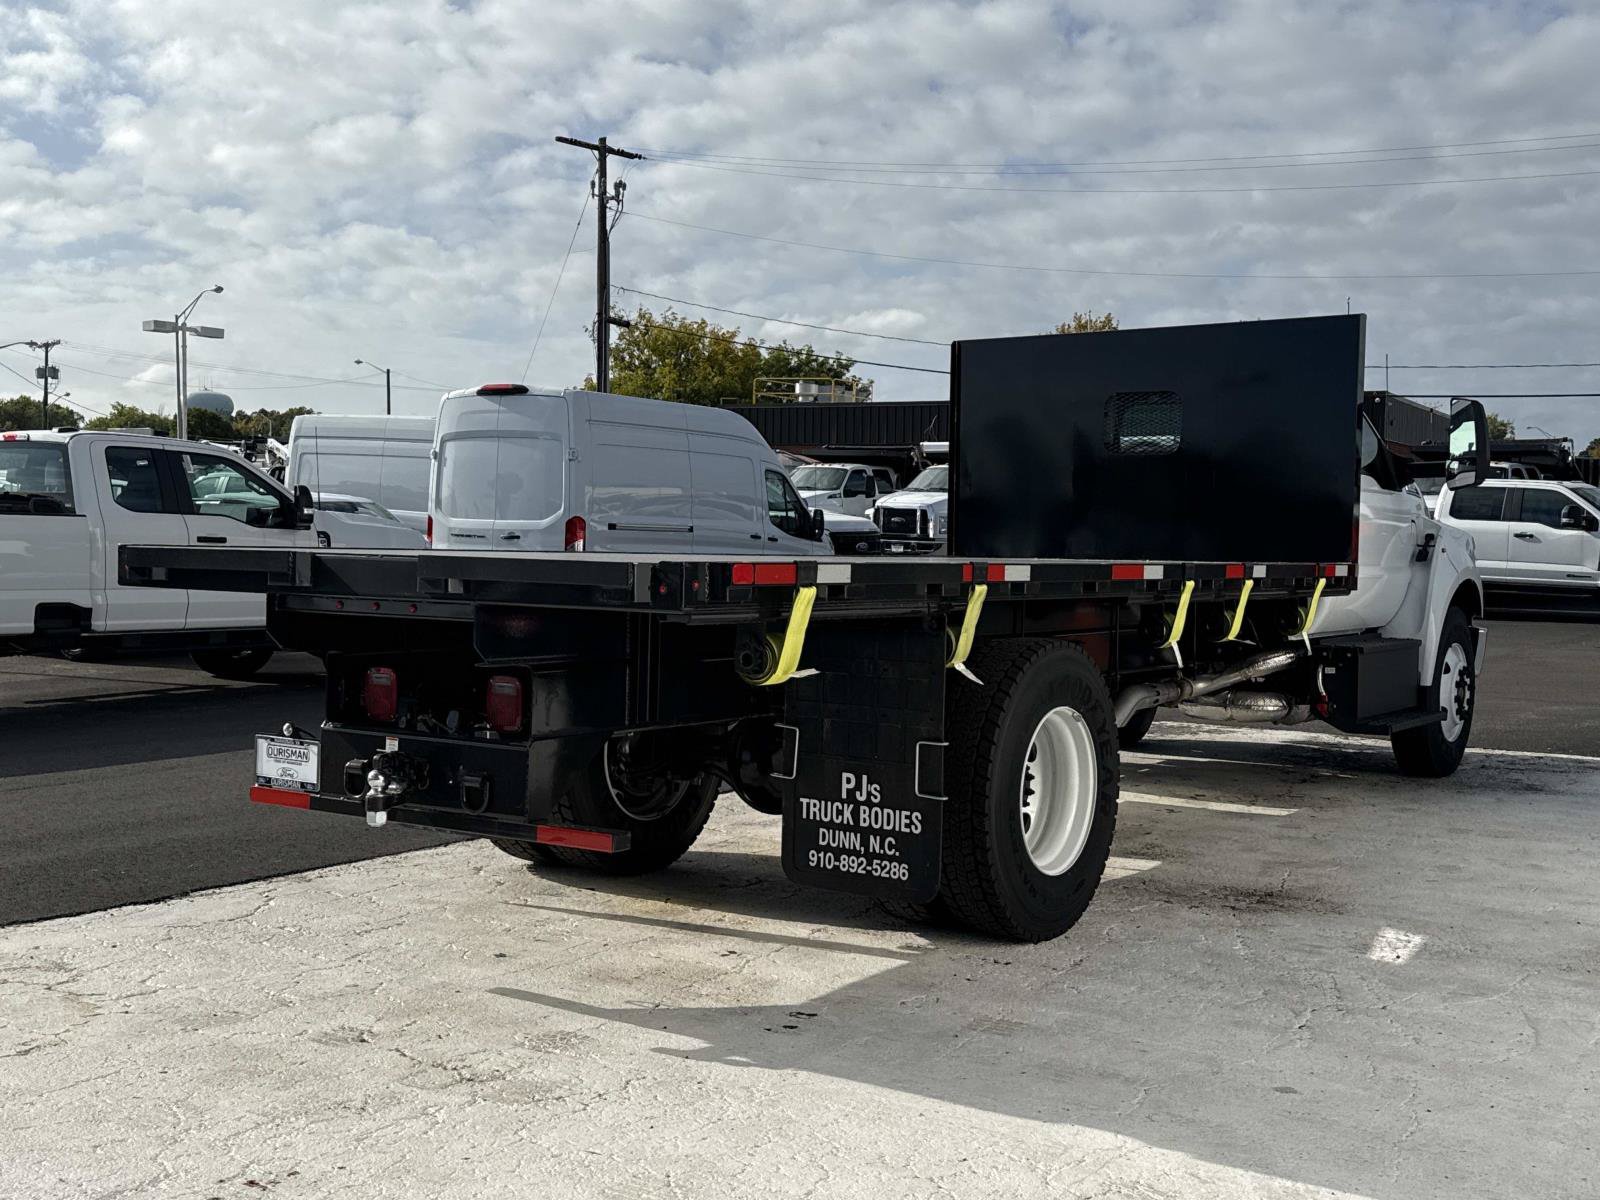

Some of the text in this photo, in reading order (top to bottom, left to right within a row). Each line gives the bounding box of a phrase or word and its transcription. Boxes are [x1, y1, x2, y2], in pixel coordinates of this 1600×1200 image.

[268, 747, 309, 760] OURISMAN
[279, 767, 295, 778] Ford
[841, 772, 881, 803] PJ's
[799, 798, 922, 834] TRUCK BODIES
[818, 828, 900, 856] DUNN, N.C.
[808, 850, 909, 881] 910-892-5286
